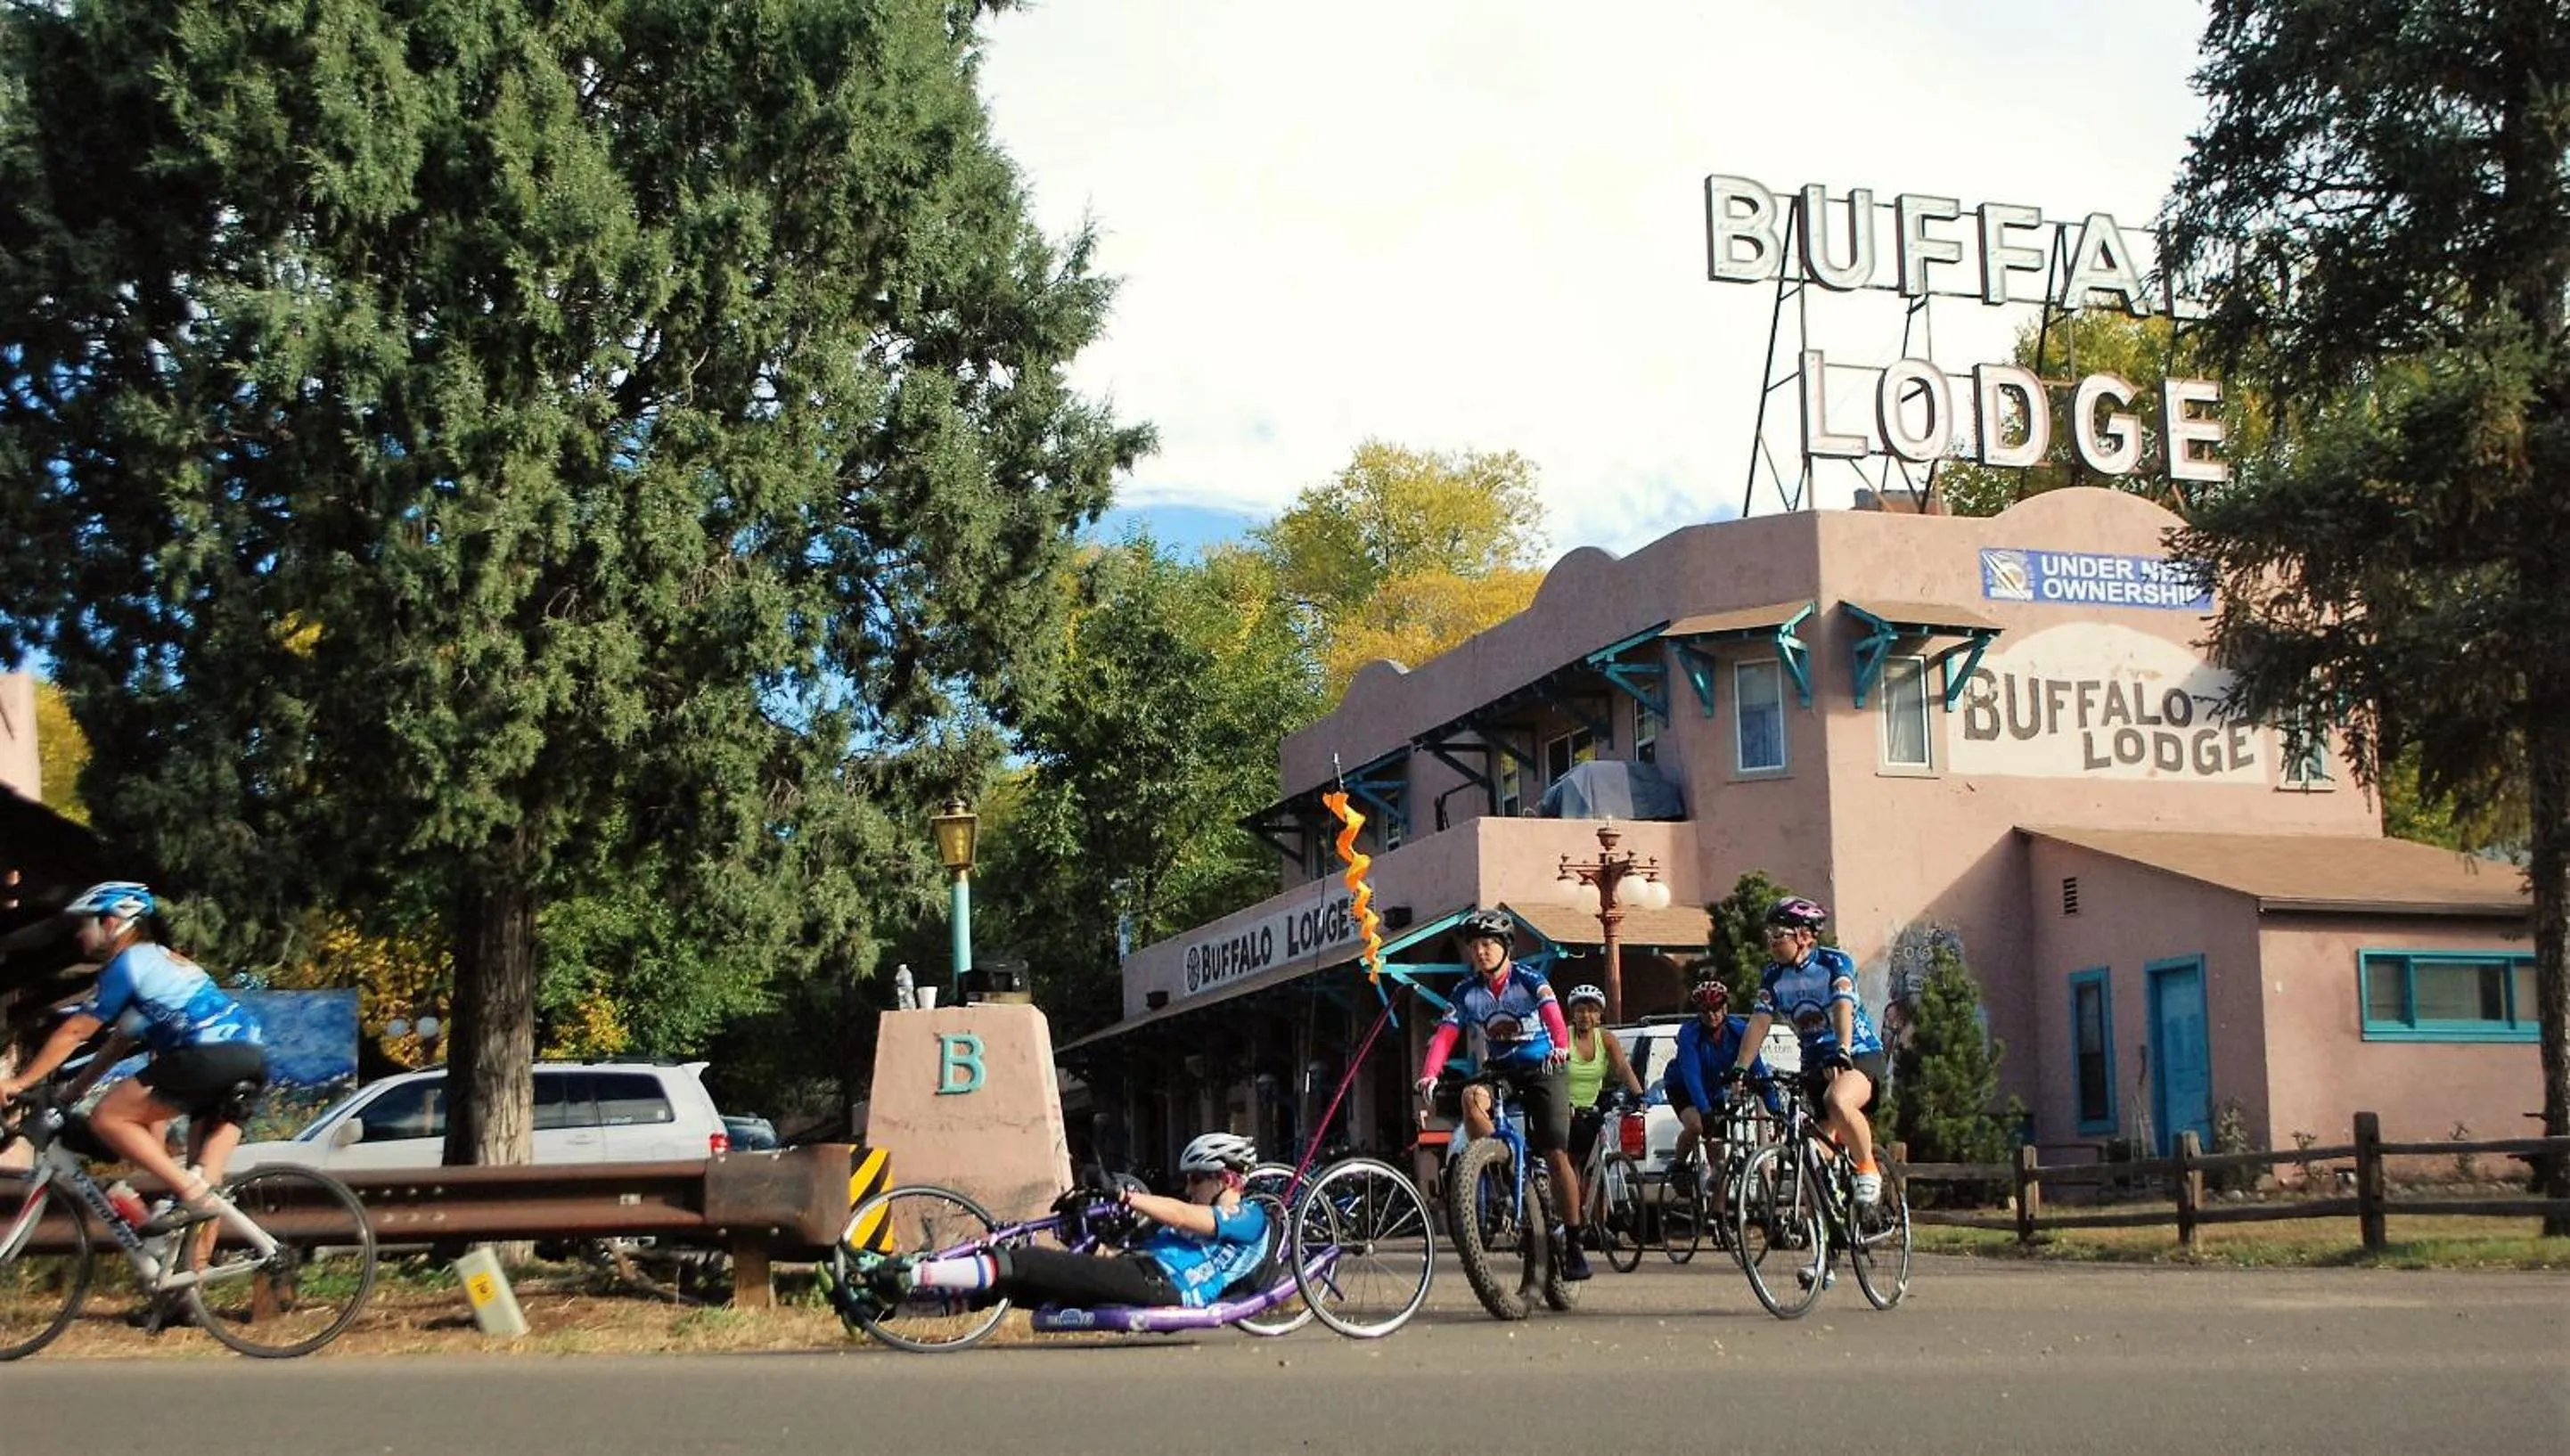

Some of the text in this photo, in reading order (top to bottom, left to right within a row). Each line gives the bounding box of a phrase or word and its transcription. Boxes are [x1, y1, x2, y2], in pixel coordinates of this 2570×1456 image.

[1705, 174, 2221, 321] BUFFAL
[1798, 349, 2228, 482] LODGE
[2041, 554, 2134, 580] UNDER
[2042, 580, 2203, 607] OWNERSHIP
[1963, 667, 2194, 741] BUFFALO
[2083, 723, 2255, 776] LODGE
[1200, 897, 1349, 985] BUFFALO LODGE
[936, 1032, 986, 1096] B
